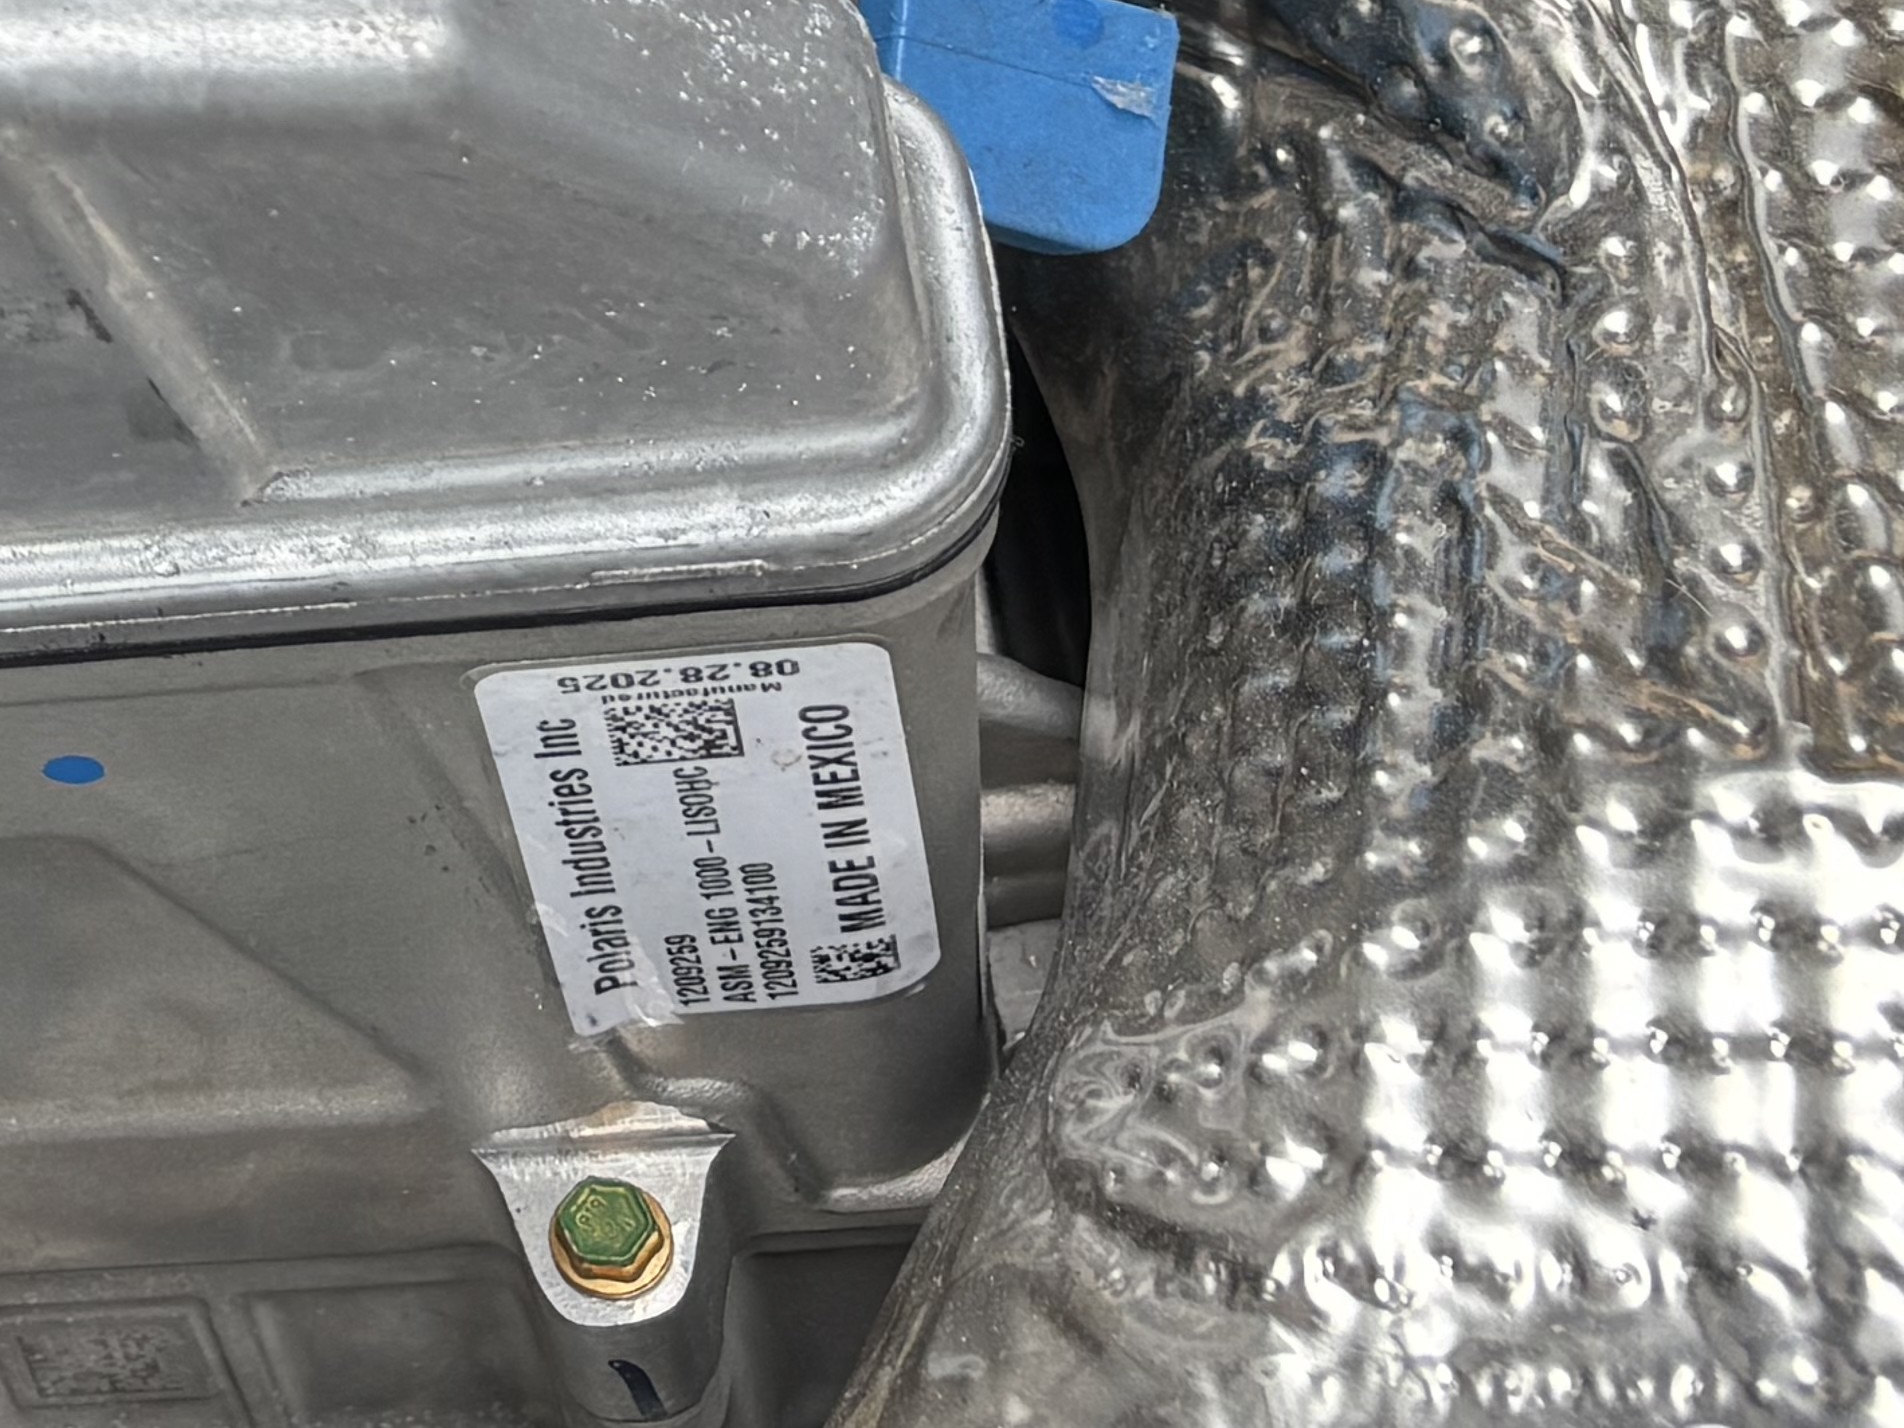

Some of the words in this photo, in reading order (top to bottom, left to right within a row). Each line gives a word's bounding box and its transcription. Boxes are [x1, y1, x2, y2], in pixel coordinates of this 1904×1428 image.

[557, 659, 800, 696] 08.28.2025
[601, 681, 783, 705] Manufactured
[534, 718, 581, 759] Inc
[799, 704, 865, 812] MEXICO
[549, 768, 615, 897] Industries
[821, 818, 871, 849] IN
[740, 861, 799, 999] 1209259134100
[830, 854, 886, 933] MADE
[582, 903, 638, 993] Polaris
[665, 934, 710, 1006] 1209259
